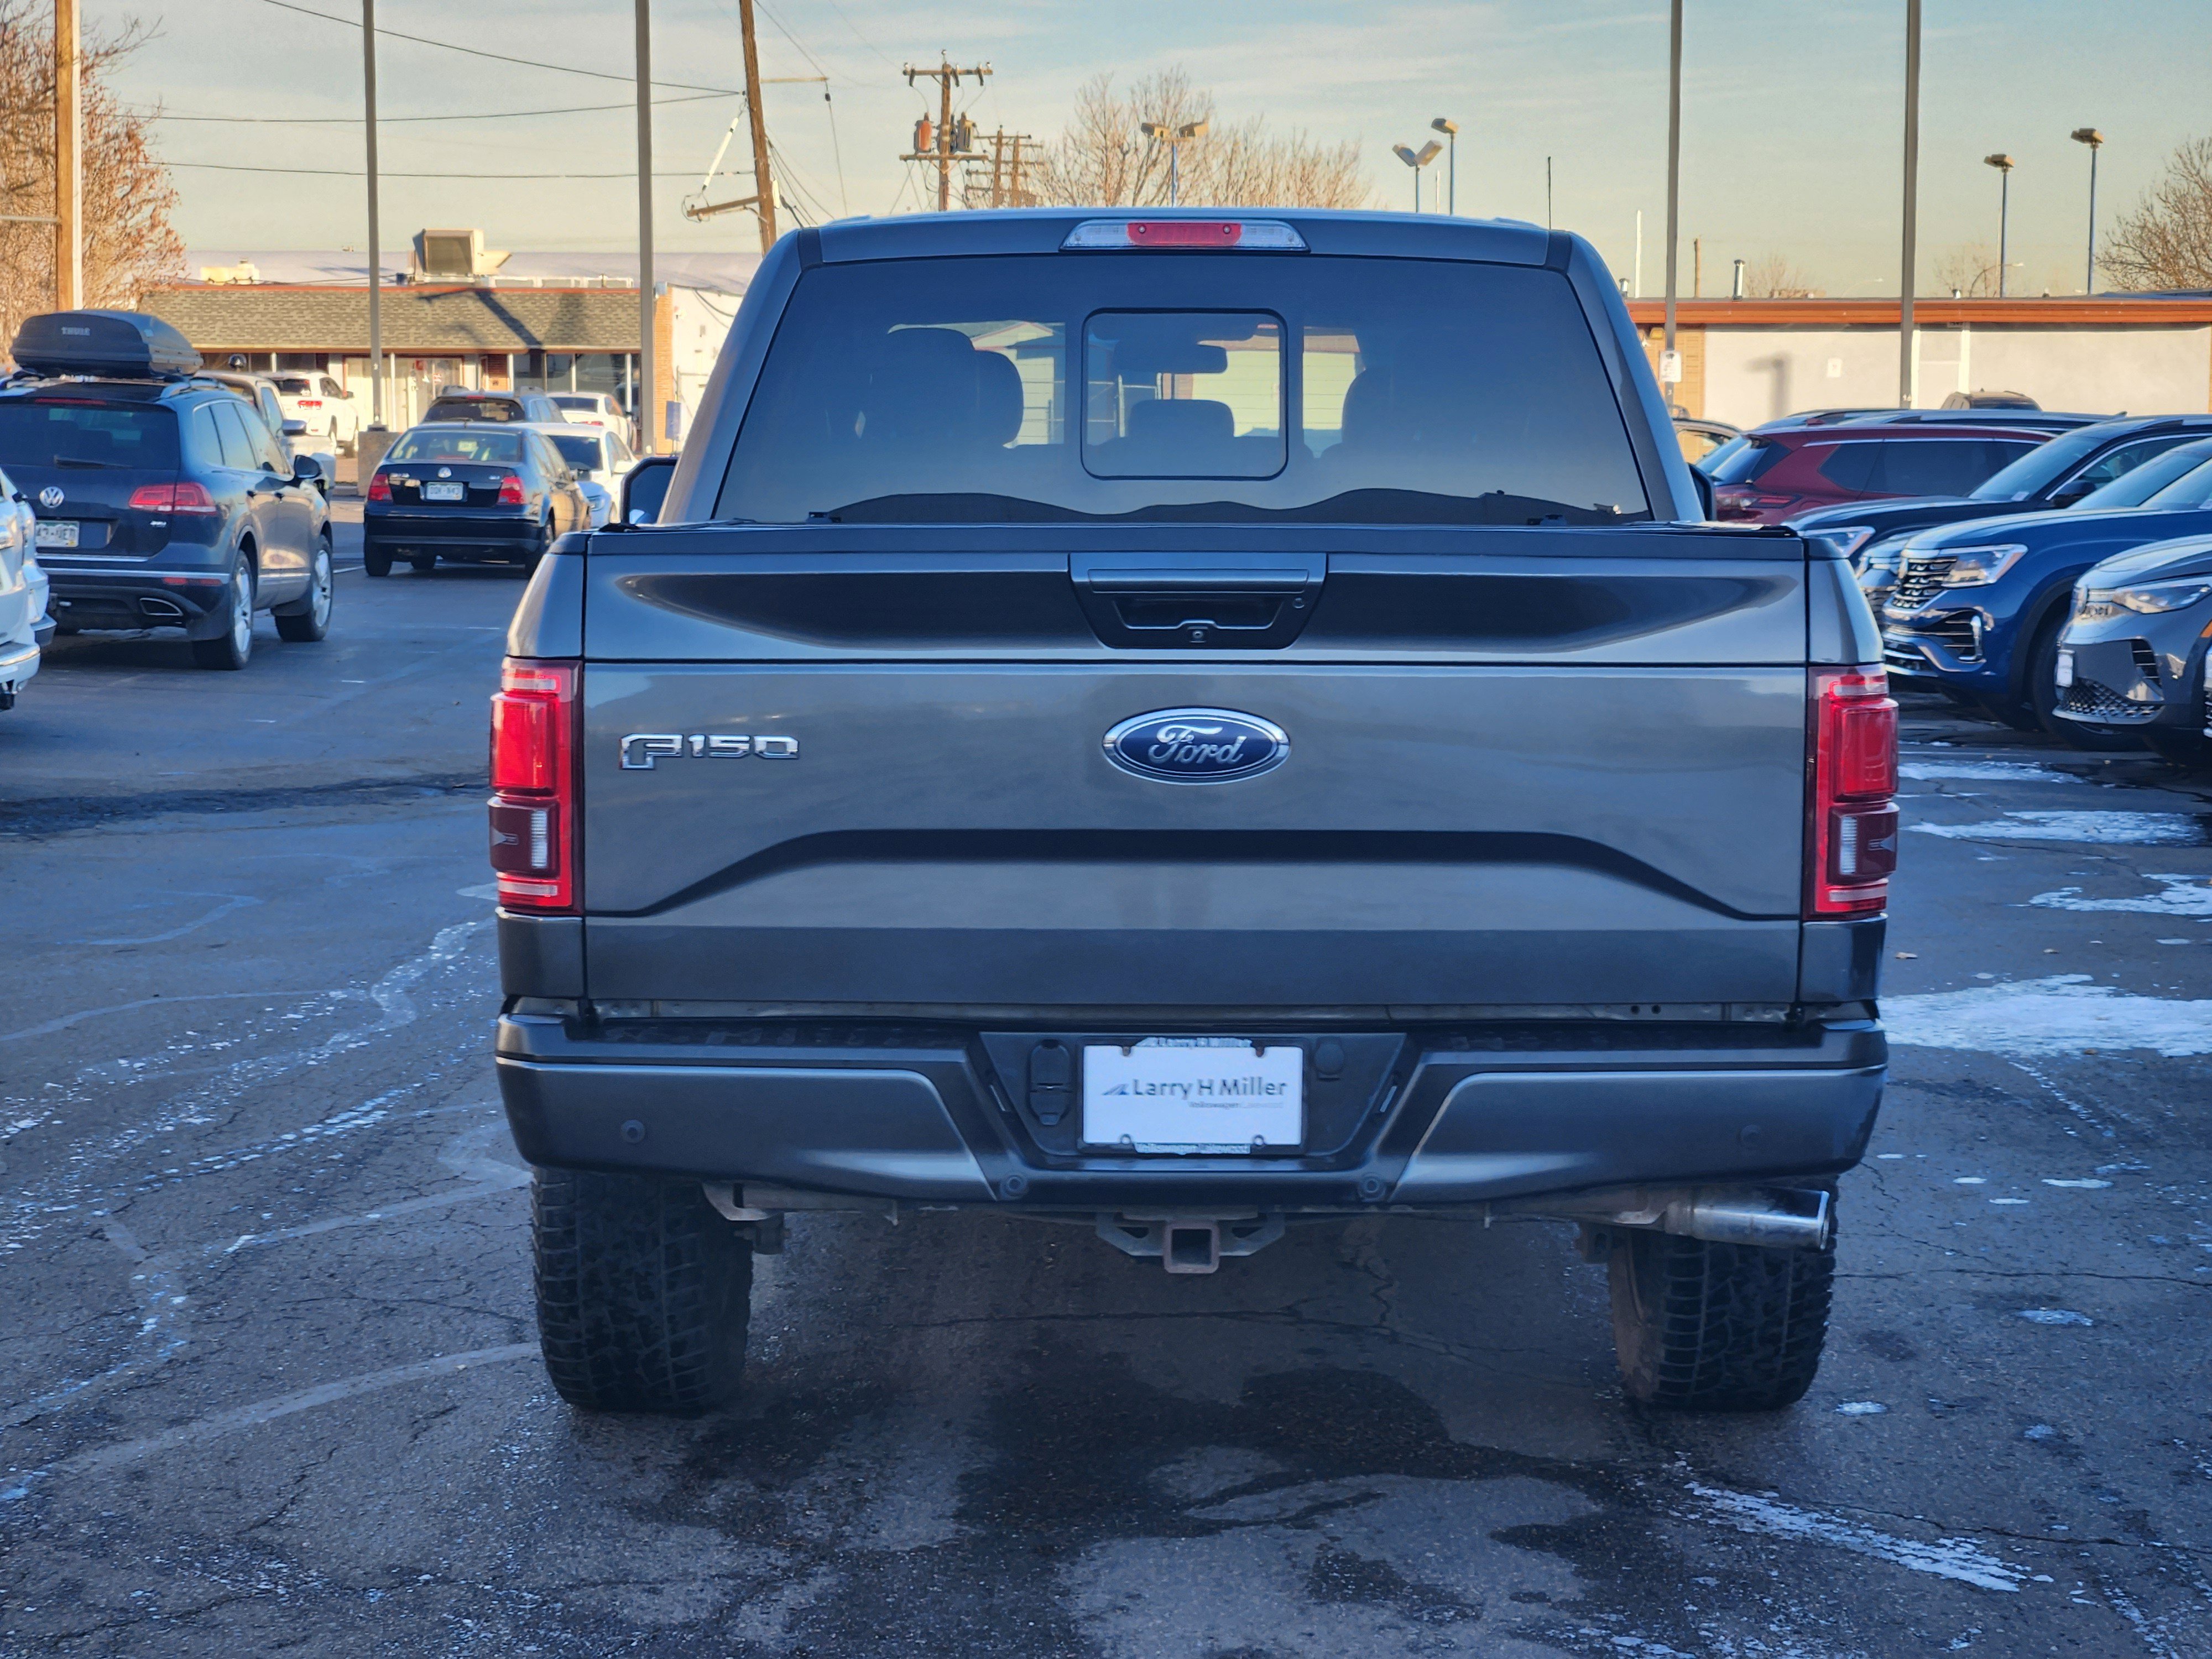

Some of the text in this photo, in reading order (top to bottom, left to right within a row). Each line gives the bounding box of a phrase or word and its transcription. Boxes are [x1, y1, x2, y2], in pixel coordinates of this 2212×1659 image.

[1148, 724, 1246, 764] Ford
[1133, 1077, 1287, 1100] Larry H Miller
